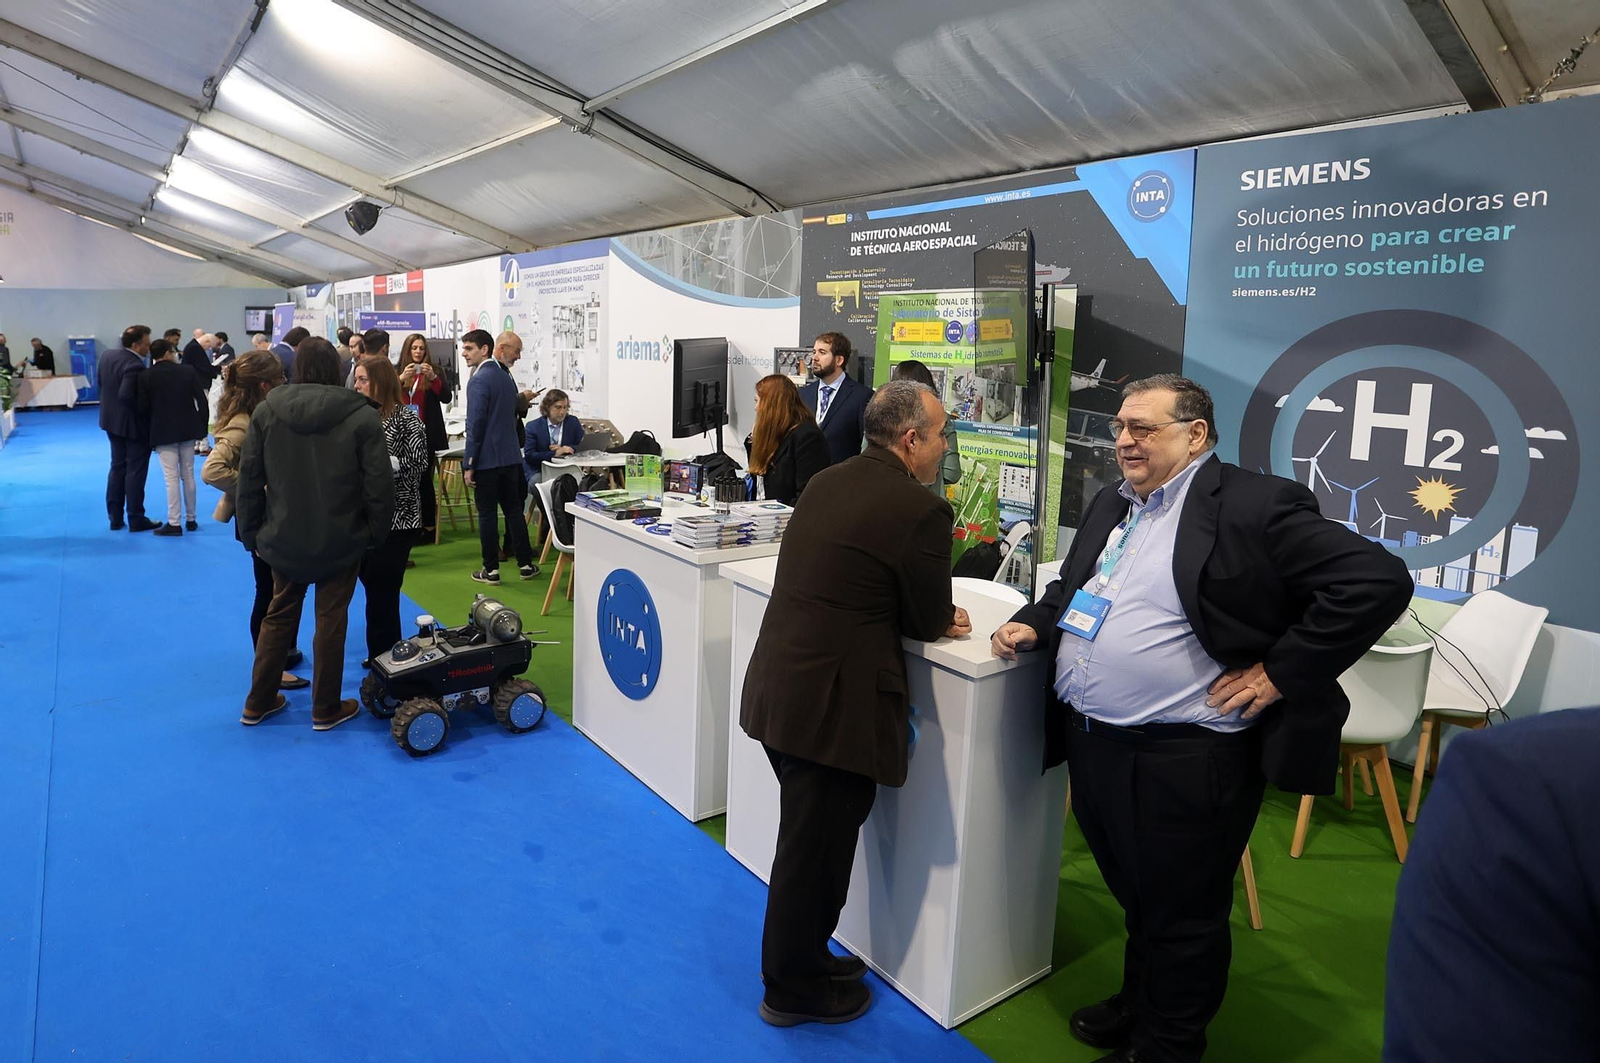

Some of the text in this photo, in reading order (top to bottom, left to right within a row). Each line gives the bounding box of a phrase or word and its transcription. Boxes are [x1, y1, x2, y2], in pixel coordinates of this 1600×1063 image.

[1240, 158, 1371, 191] SIEMENS
[984, 190, 1031, 204] www.inta.es
[1136, 190, 1165, 202] INTA
[1236, 188, 1548, 228] Soluciones innovadoras en
[850, 222, 952, 242] INSTITUTO NACIONAL
[1235, 222, 1516, 255] el hidrógeno para crear
[850, 246, 862, 256] DE
[864, 242, 902, 256] TÉCNICA
[903, 234, 978, 252] AEROESPACIAL
[1234, 253, 1485, 279] un futuro sostenible
[1232, 286, 1316, 298] siemens.es/H2
[926, 298, 959, 306] NACIONAL
[893, 308, 940, 318] Laboratorio
[943, 308, 954, 318] de
[617, 335, 661, 362] ariema
[910, 350, 941, 359] Sistemas
[943, 351, 953, 360] de
[733, 355, 744, 365] del
[1350, 380, 1465, 472] H2
[960, 443, 1037, 460] energías renovabes
[1480, 545, 1501, 559] H2
[610, 612, 646, 655] INTA
